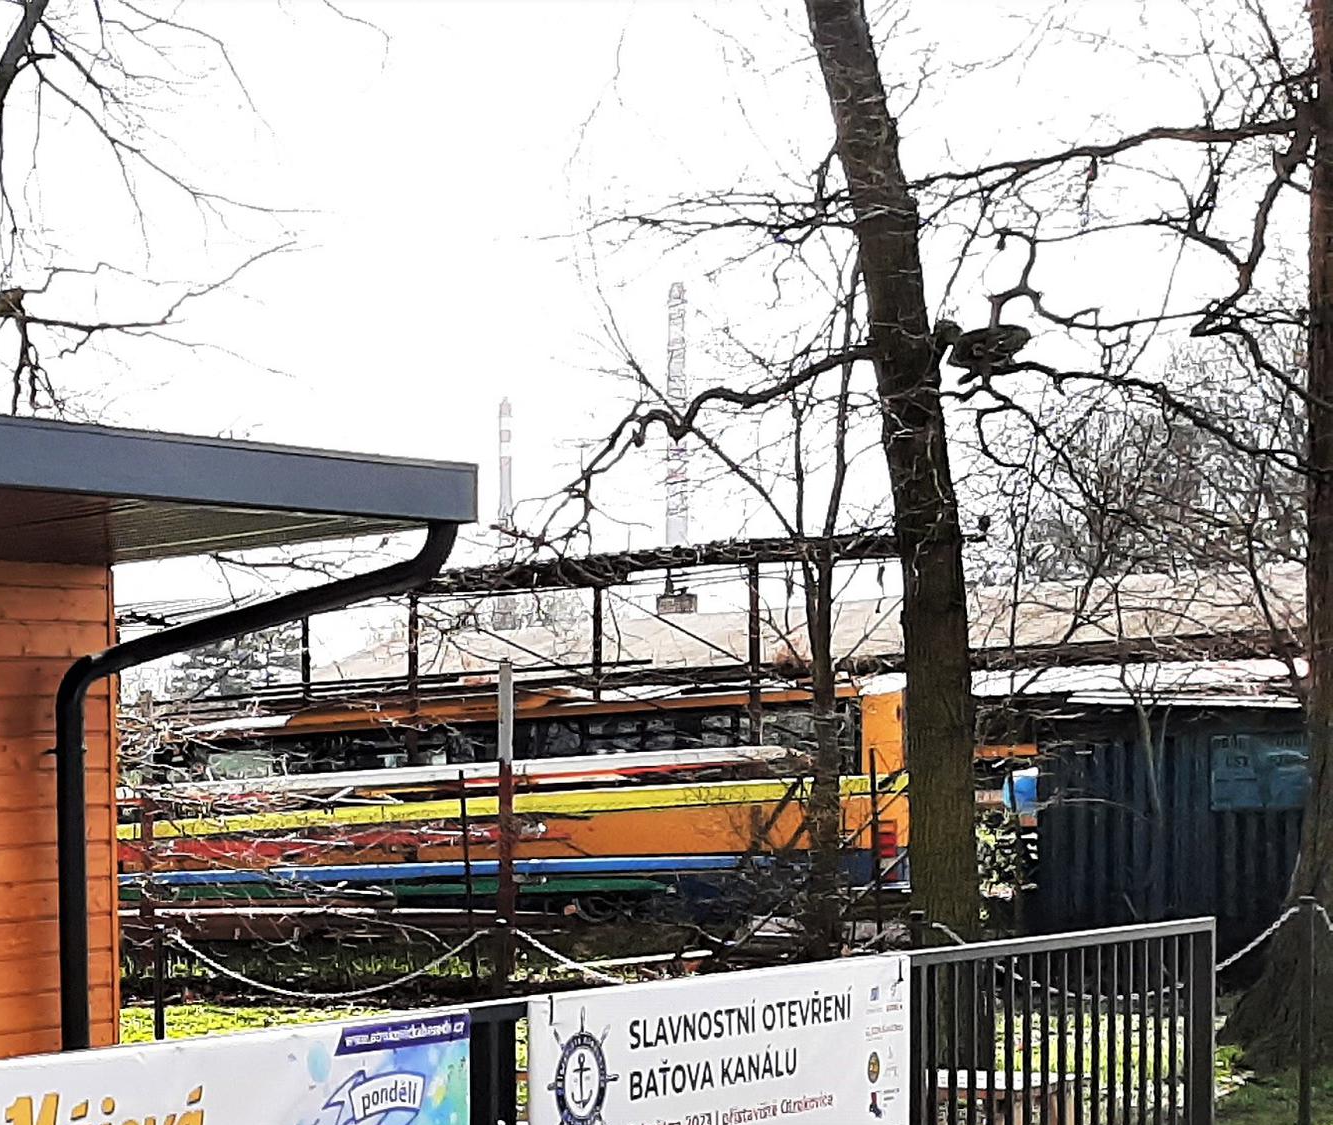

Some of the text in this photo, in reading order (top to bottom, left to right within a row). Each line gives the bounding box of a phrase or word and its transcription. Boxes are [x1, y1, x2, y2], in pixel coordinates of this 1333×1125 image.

[629, 986, 853, 1050] SLAVNOSTNÍ OTEVŘENÍ
[362, 1080, 417, 1112] pondělí
[629, 1047, 798, 1101] BAŤOVA KANÁLU
